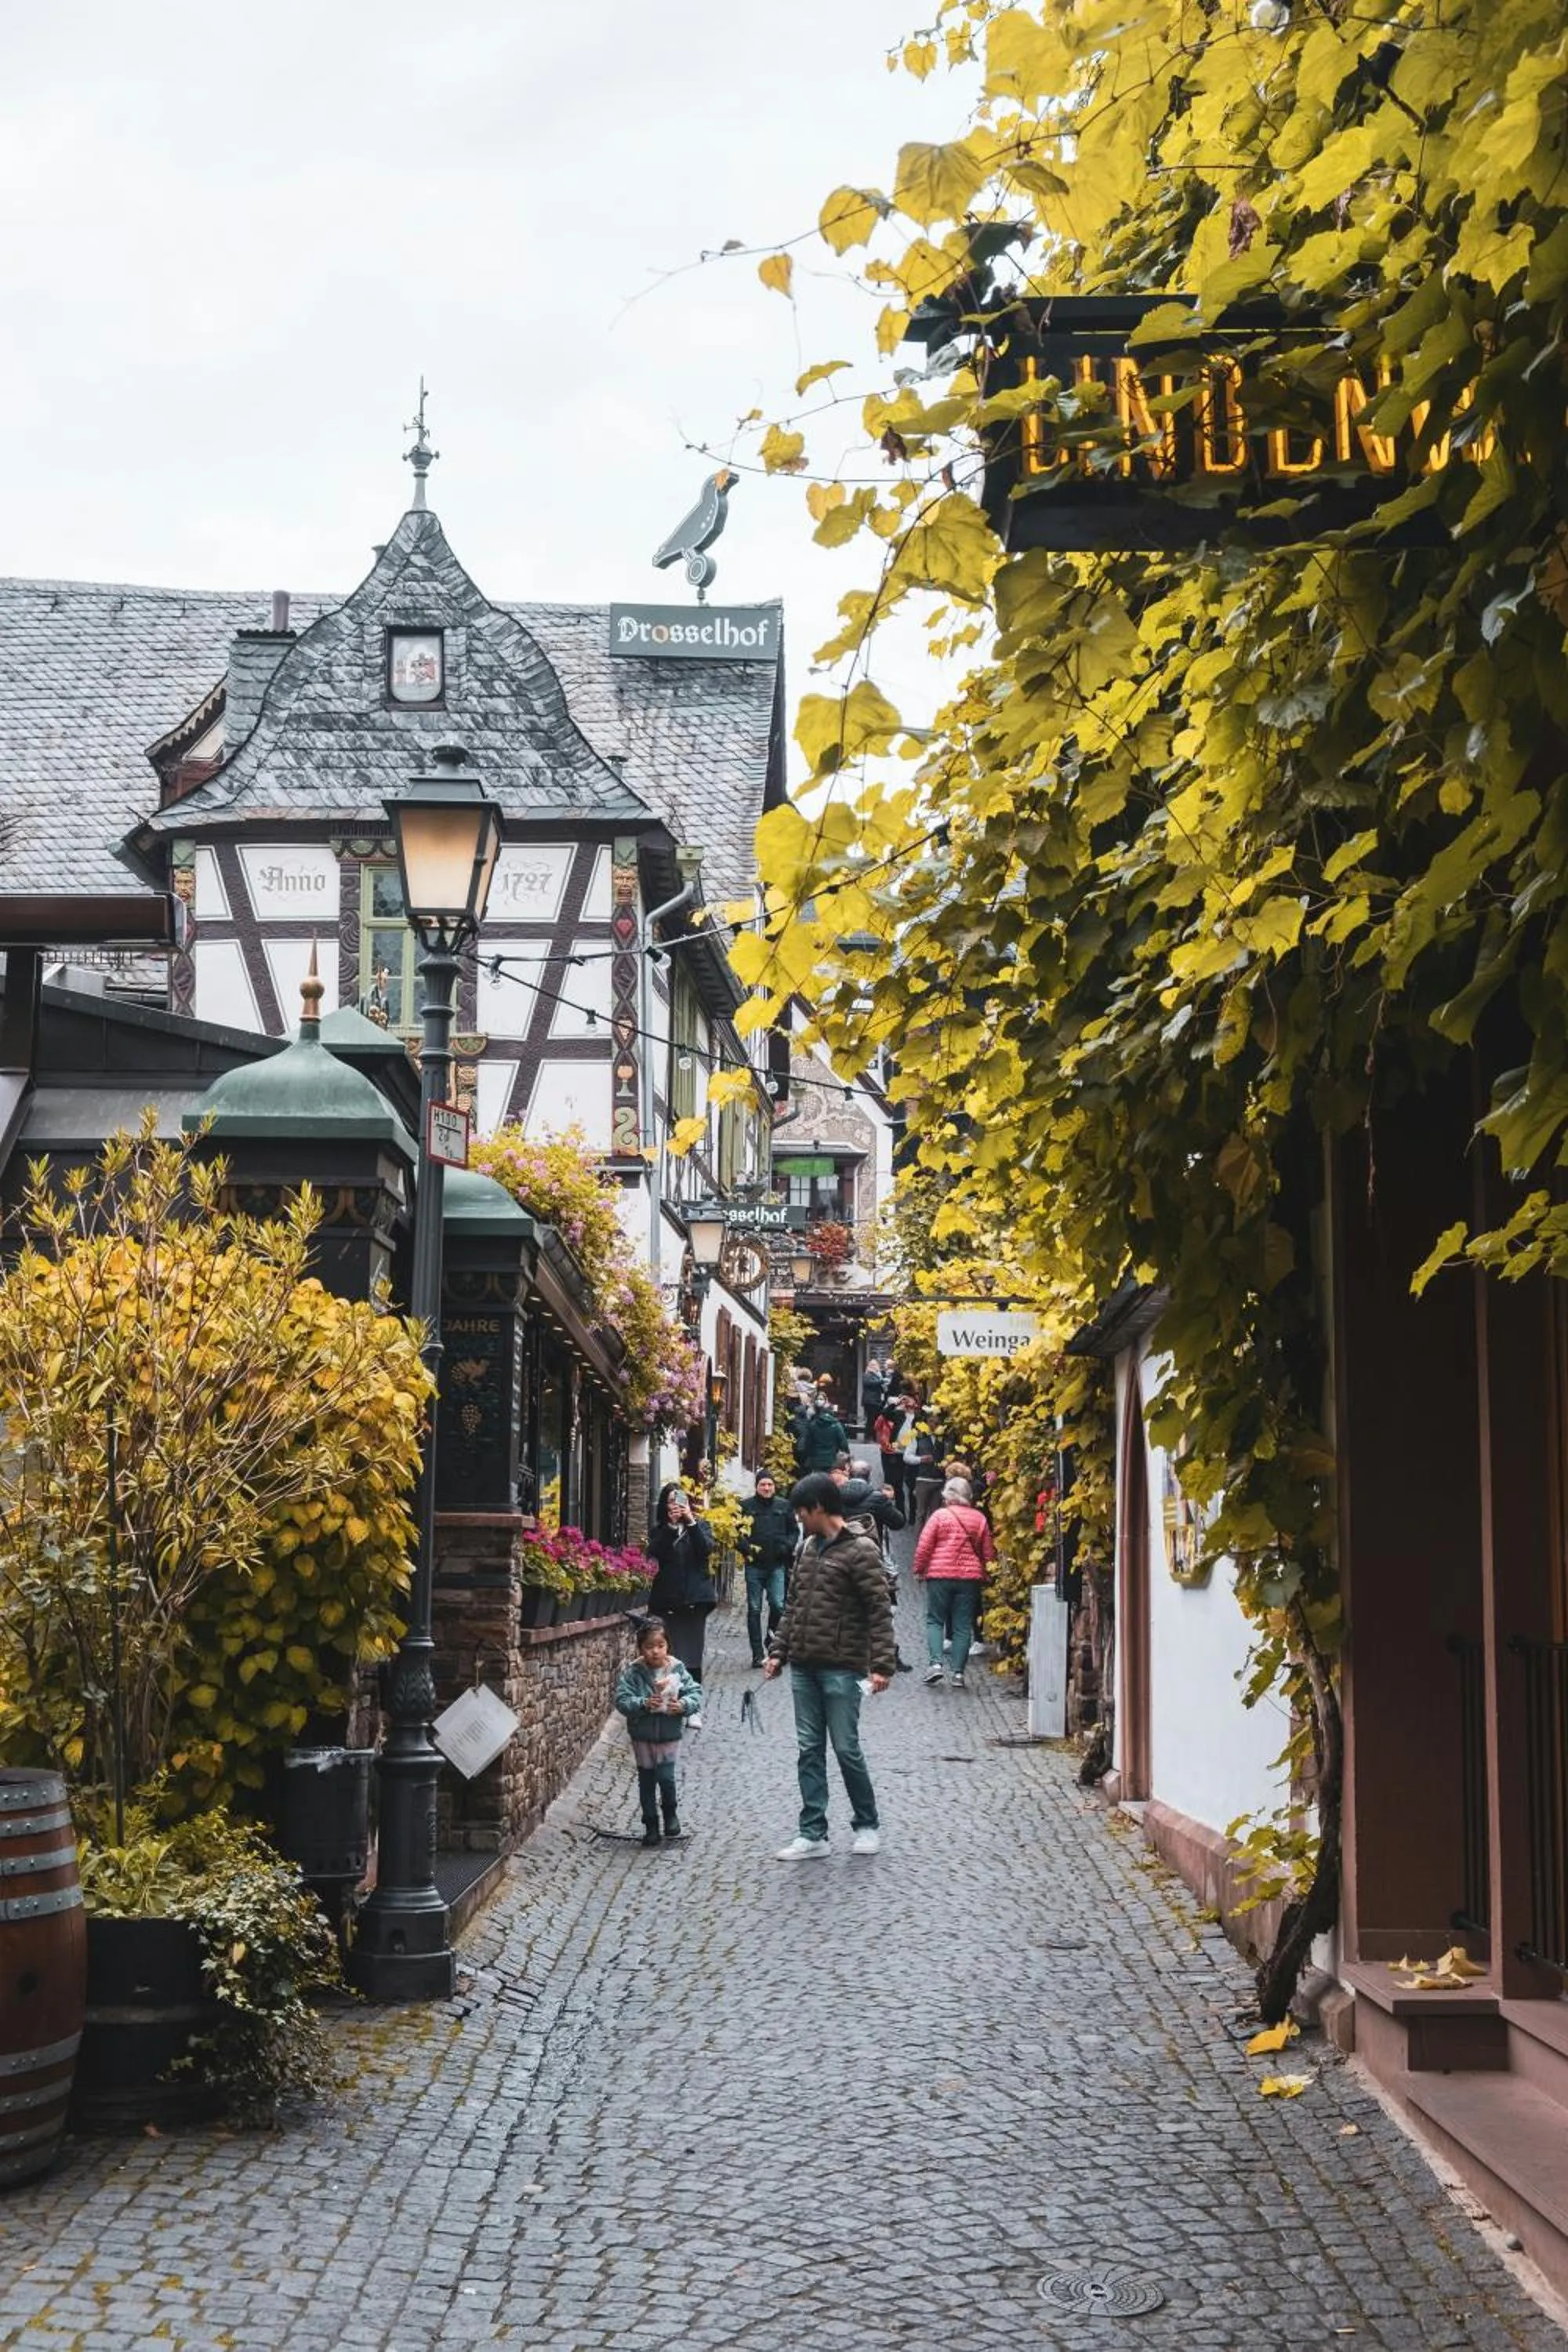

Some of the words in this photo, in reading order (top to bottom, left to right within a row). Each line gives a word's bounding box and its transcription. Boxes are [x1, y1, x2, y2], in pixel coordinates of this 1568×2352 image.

[618, 615, 770, 648] Drosselhof
[258, 866, 326, 892] Anno
[723, 1206, 788, 1225] sselhof
[442, 1319, 501, 1333] JAHRE
[952, 1329, 1030, 1356] Weinga
